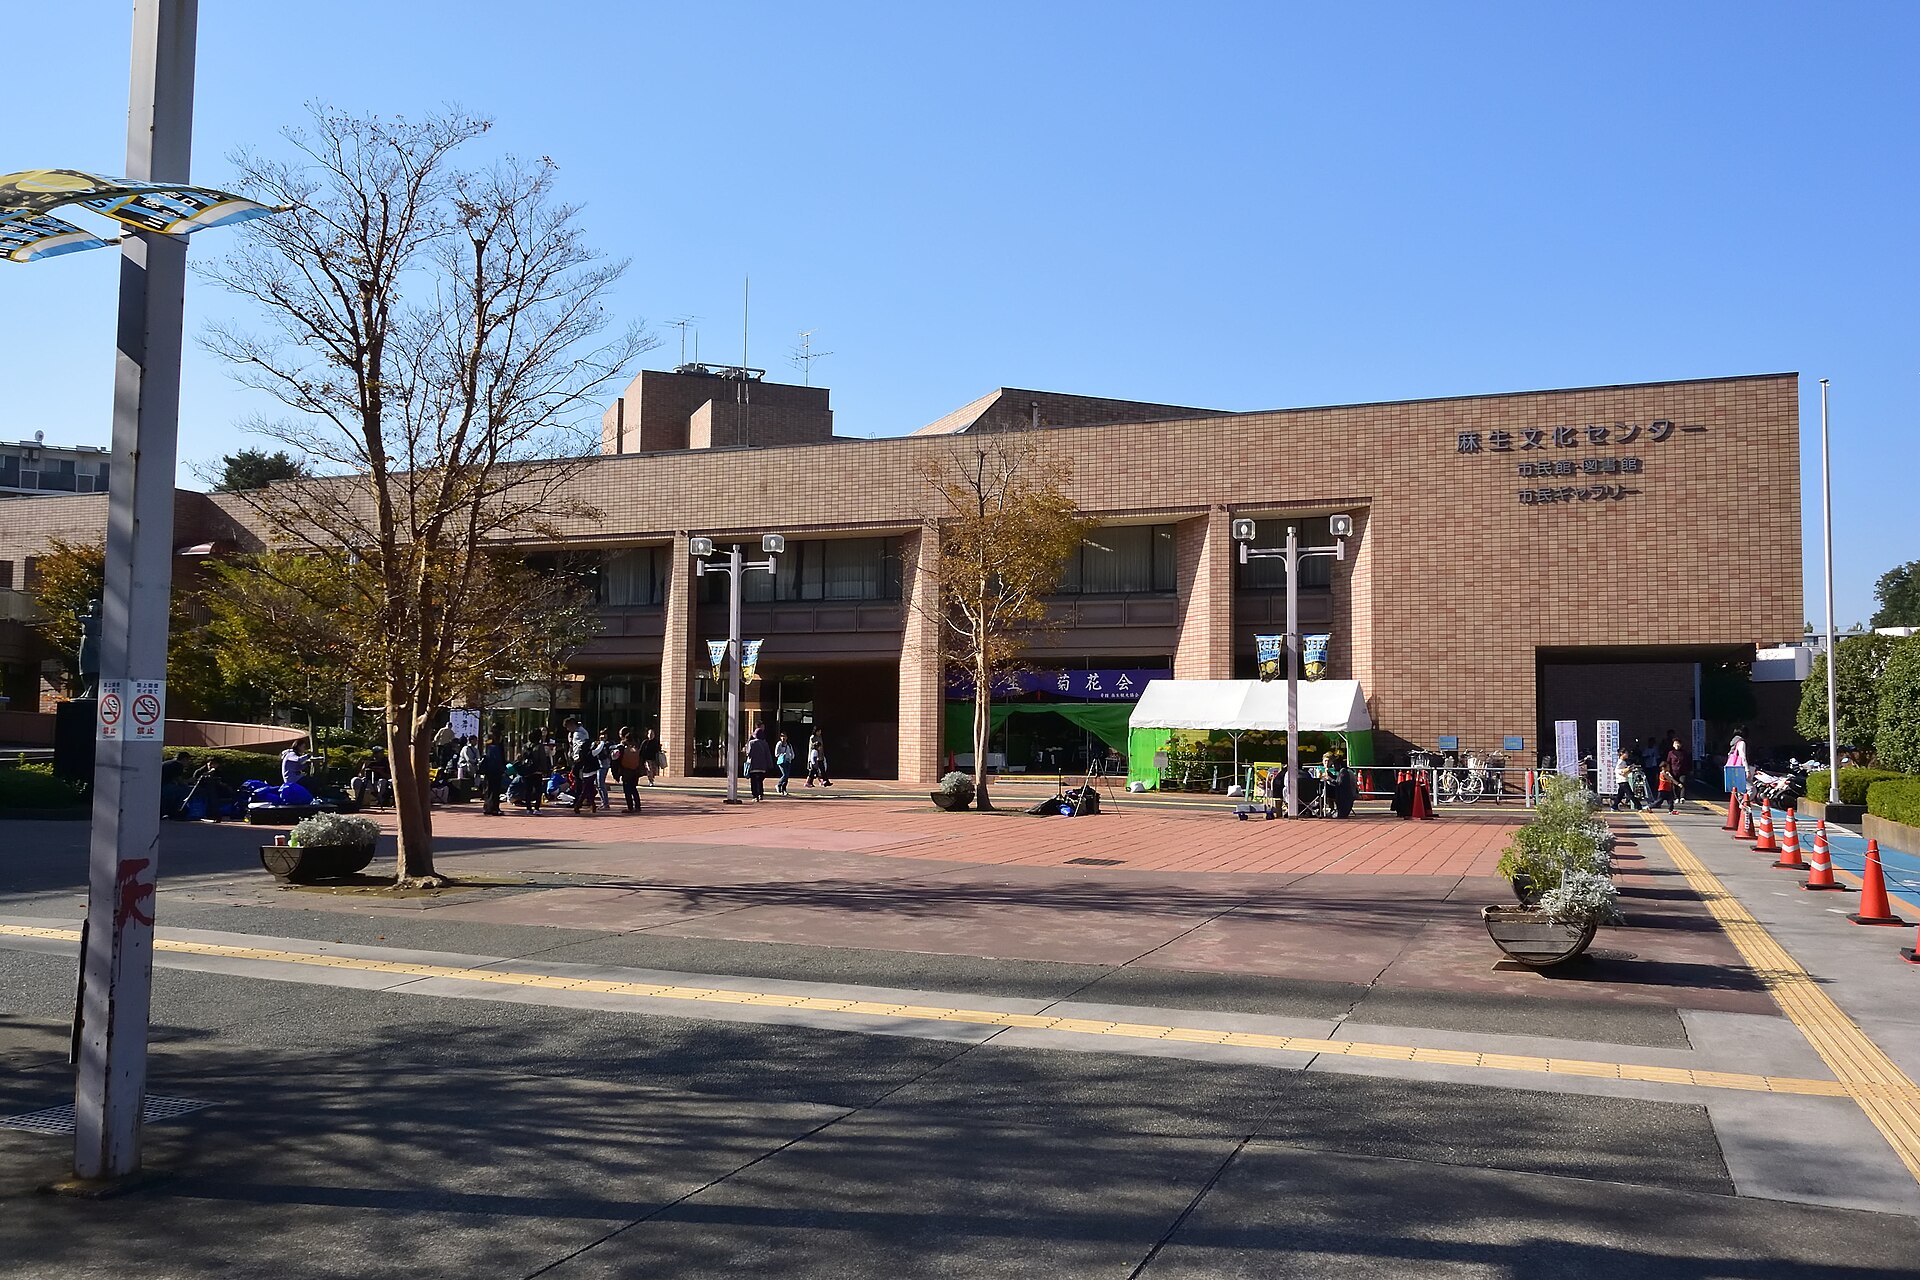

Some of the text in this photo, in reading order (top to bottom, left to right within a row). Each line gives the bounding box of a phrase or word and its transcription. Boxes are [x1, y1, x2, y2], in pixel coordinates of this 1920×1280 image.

[1457, 419, 1705, 452] 麻生文化センター
[1057, 673, 1134, 692] 菊花会
